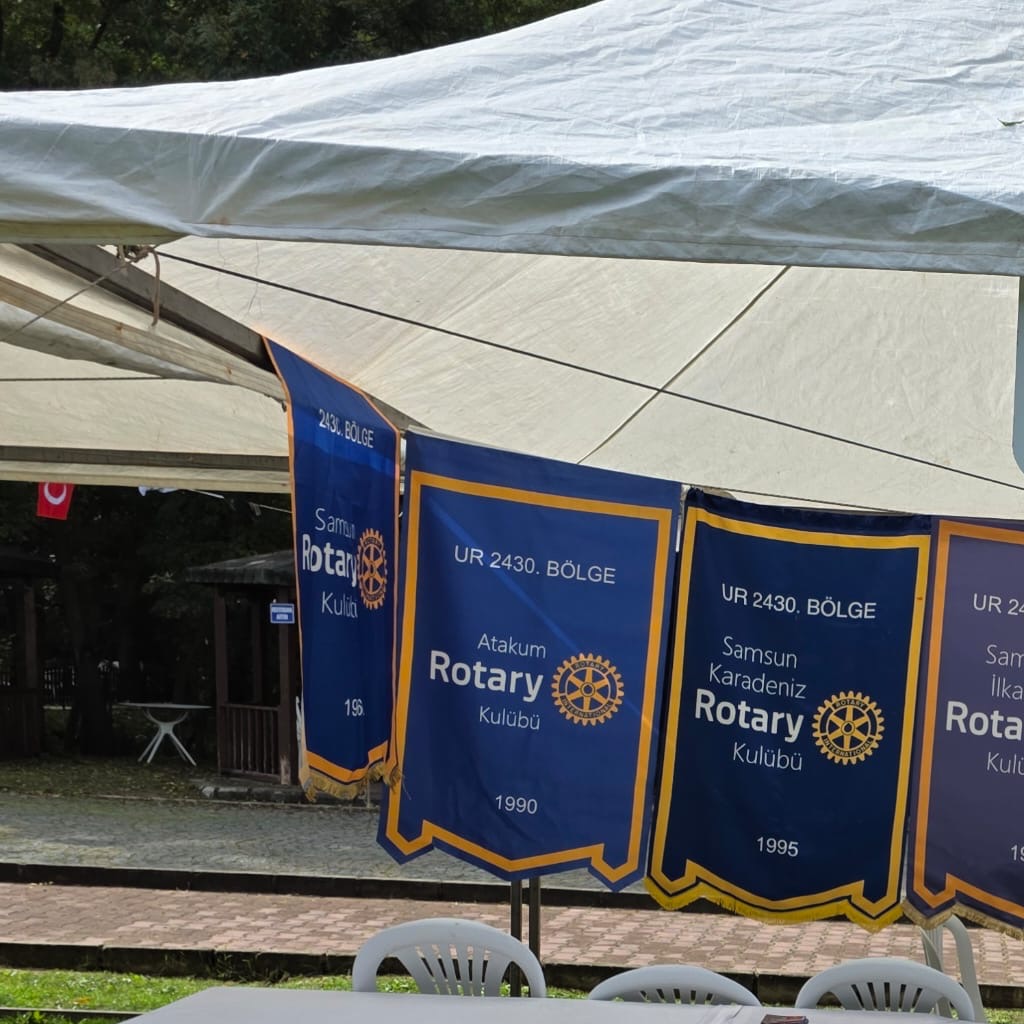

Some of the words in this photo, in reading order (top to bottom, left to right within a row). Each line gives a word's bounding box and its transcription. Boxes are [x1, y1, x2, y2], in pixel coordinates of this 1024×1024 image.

[344, 420, 374, 449] BÖLGE
[302, 533, 357, 588] Rotary
[454, 545, 485, 567] UR
[489, 551, 541, 576] 2430.
[546, 559, 617, 585] BÖLGE
[721, 583, 748, 606] UR
[752, 591, 801, 615] 2430.
[807, 596, 877, 620] BÖLGE
[973, 592, 1002, 614] UR
[477, 633, 547, 659] Atakum
[722, 636, 798, 669] Samsun
[430, 650, 544, 701] Rotary
[709, 662, 807, 699] Karadeniz
[479, 705, 541, 731] Kulübü
[695, 688, 804, 743] Rotary
[732, 741, 803, 771] Kulübü
[495, 795, 538, 815] 1990
[756, 836, 799, 857] 1995
